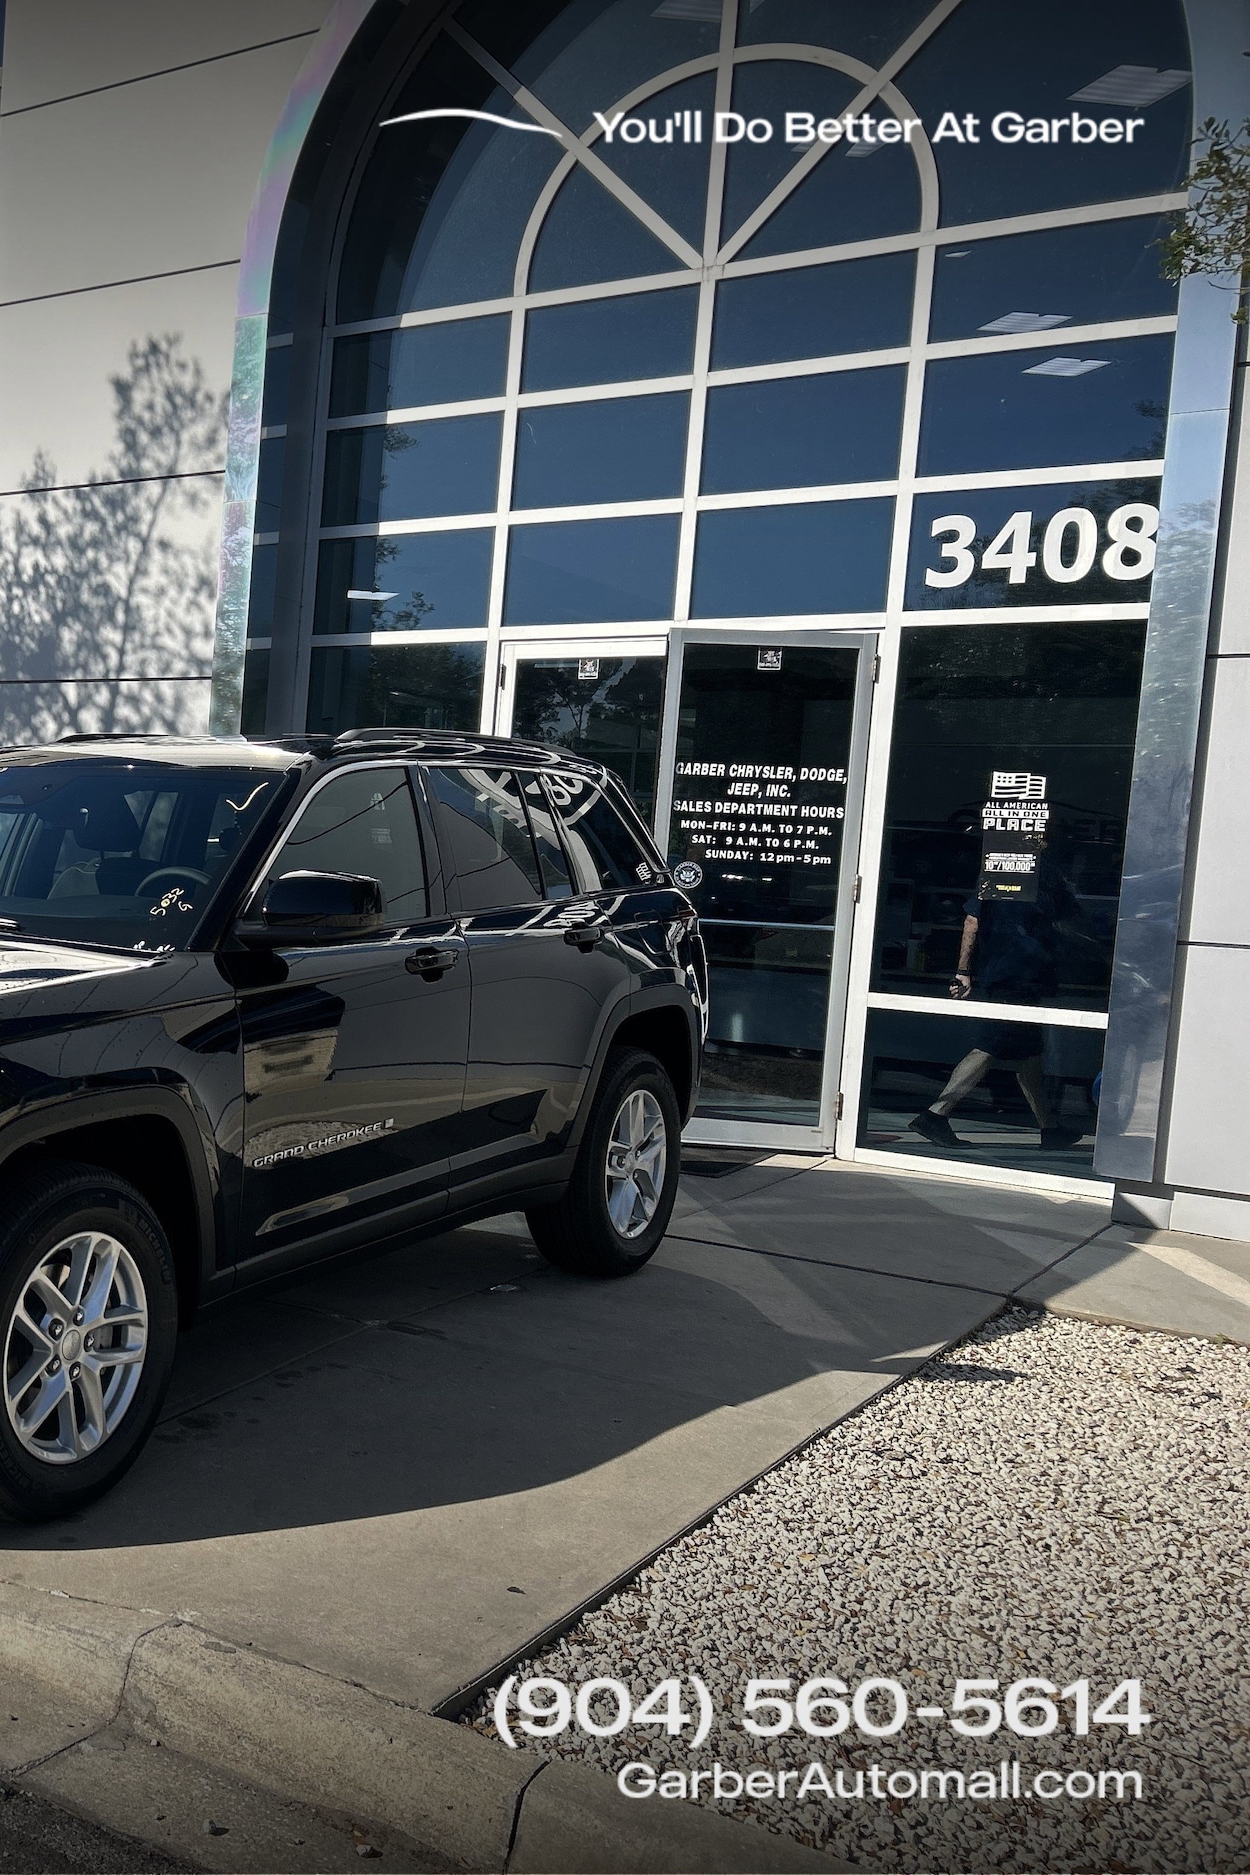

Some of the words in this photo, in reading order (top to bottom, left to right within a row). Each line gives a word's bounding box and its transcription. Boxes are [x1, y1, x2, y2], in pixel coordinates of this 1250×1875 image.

[924, 502, 1161, 588] 3408
[676, 762, 726, 777] GARBER
[729, 764, 797, 782] CHRYSLER,
[800, 767, 848, 784] DODGE,
[727, 783, 762, 798] JEEP,
[766, 784, 791, 797] INC.
[673, 800, 712, 813] SALES
[714, 802, 798, 817] DEPARTMENT
[801, 805, 845, 819] HOURS
[985, 801, 1001, 809] ALL
[1003, 802, 1048, 810] AMERICAN
[738, 823, 746, 832] 9
[750, 823, 776, 833] A.M.
[778, 824, 794, 834] TO
[796, 825, 804, 835] 7
[806, 826, 833, 836] P.M.
[983, 818, 1047, 832] PLACE
[691, 835, 717, 845] SAT:
[725, 836, 733, 846] 9
[736, 837, 762, 847] A.M.
[765, 837, 780, 847] TO
[783, 838, 791, 848] 6
[794, 839, 820, 850] P.M.
[704, 849, 754, 861] SUNDAY:
[253, 1145, 305, 1168] GRAND
[307, 1121, 383, 1150] CHEROKEE
